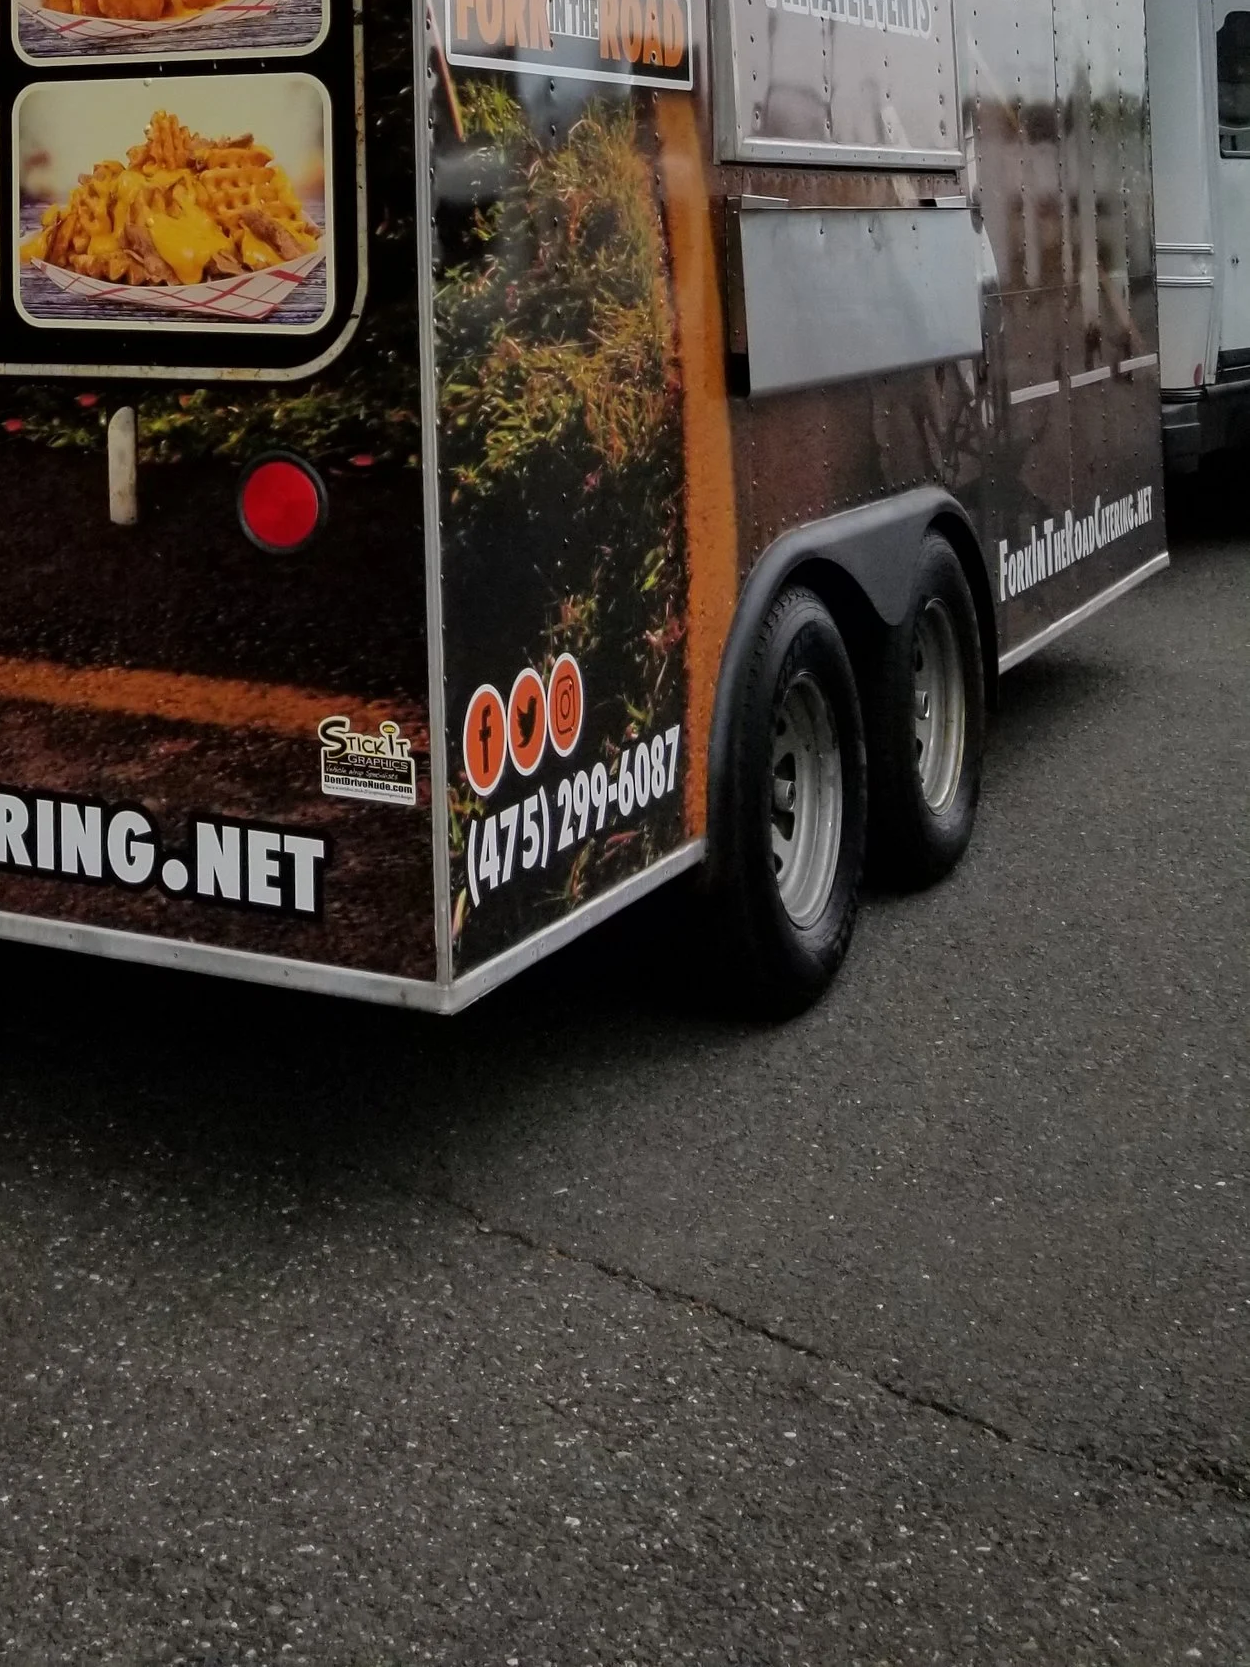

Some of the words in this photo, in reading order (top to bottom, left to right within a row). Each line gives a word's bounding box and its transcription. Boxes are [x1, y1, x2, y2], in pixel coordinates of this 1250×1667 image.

[569, 0, 598, 38] THE
[348, 754, 409, 771] GRAPHICS
[467, 785, 549, 908] (475)
[557, 724, 680, 852] 299-6087
